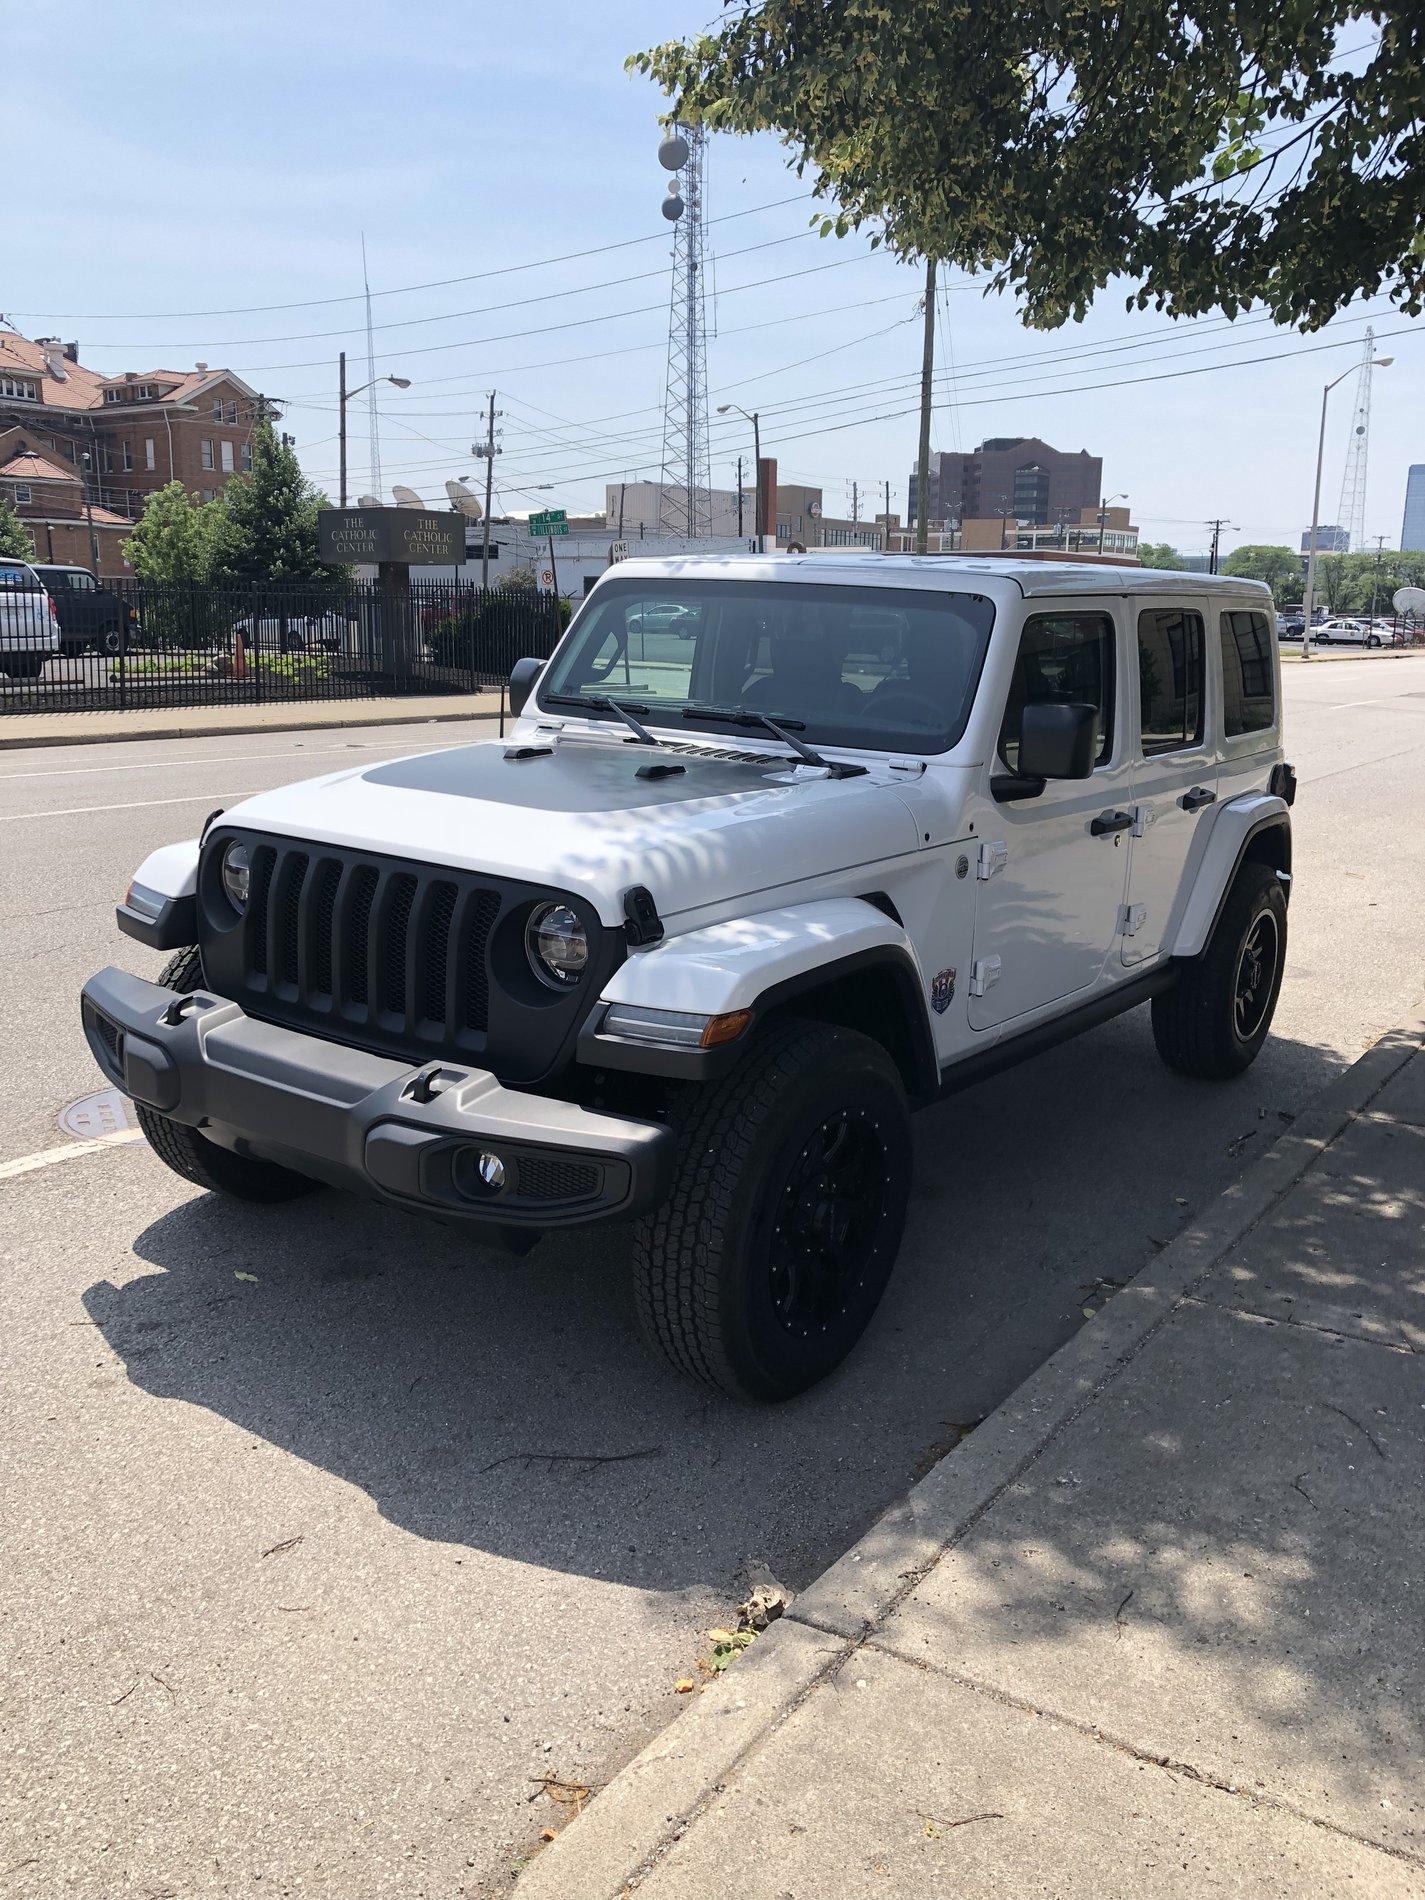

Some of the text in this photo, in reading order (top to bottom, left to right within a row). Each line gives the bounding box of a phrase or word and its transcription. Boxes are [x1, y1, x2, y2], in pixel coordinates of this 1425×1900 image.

[344, 517, 364, 528] THE
[418, 518, 438, 530] THE
[331, 529, 376, 541] CATHOLIC
[403, 529, 453, 543] CATHOLIC
[336, 542, 375, 553] CENTER
[409, 542, 449, 555] CENTER
[614, 542, 627, 553] ONE
